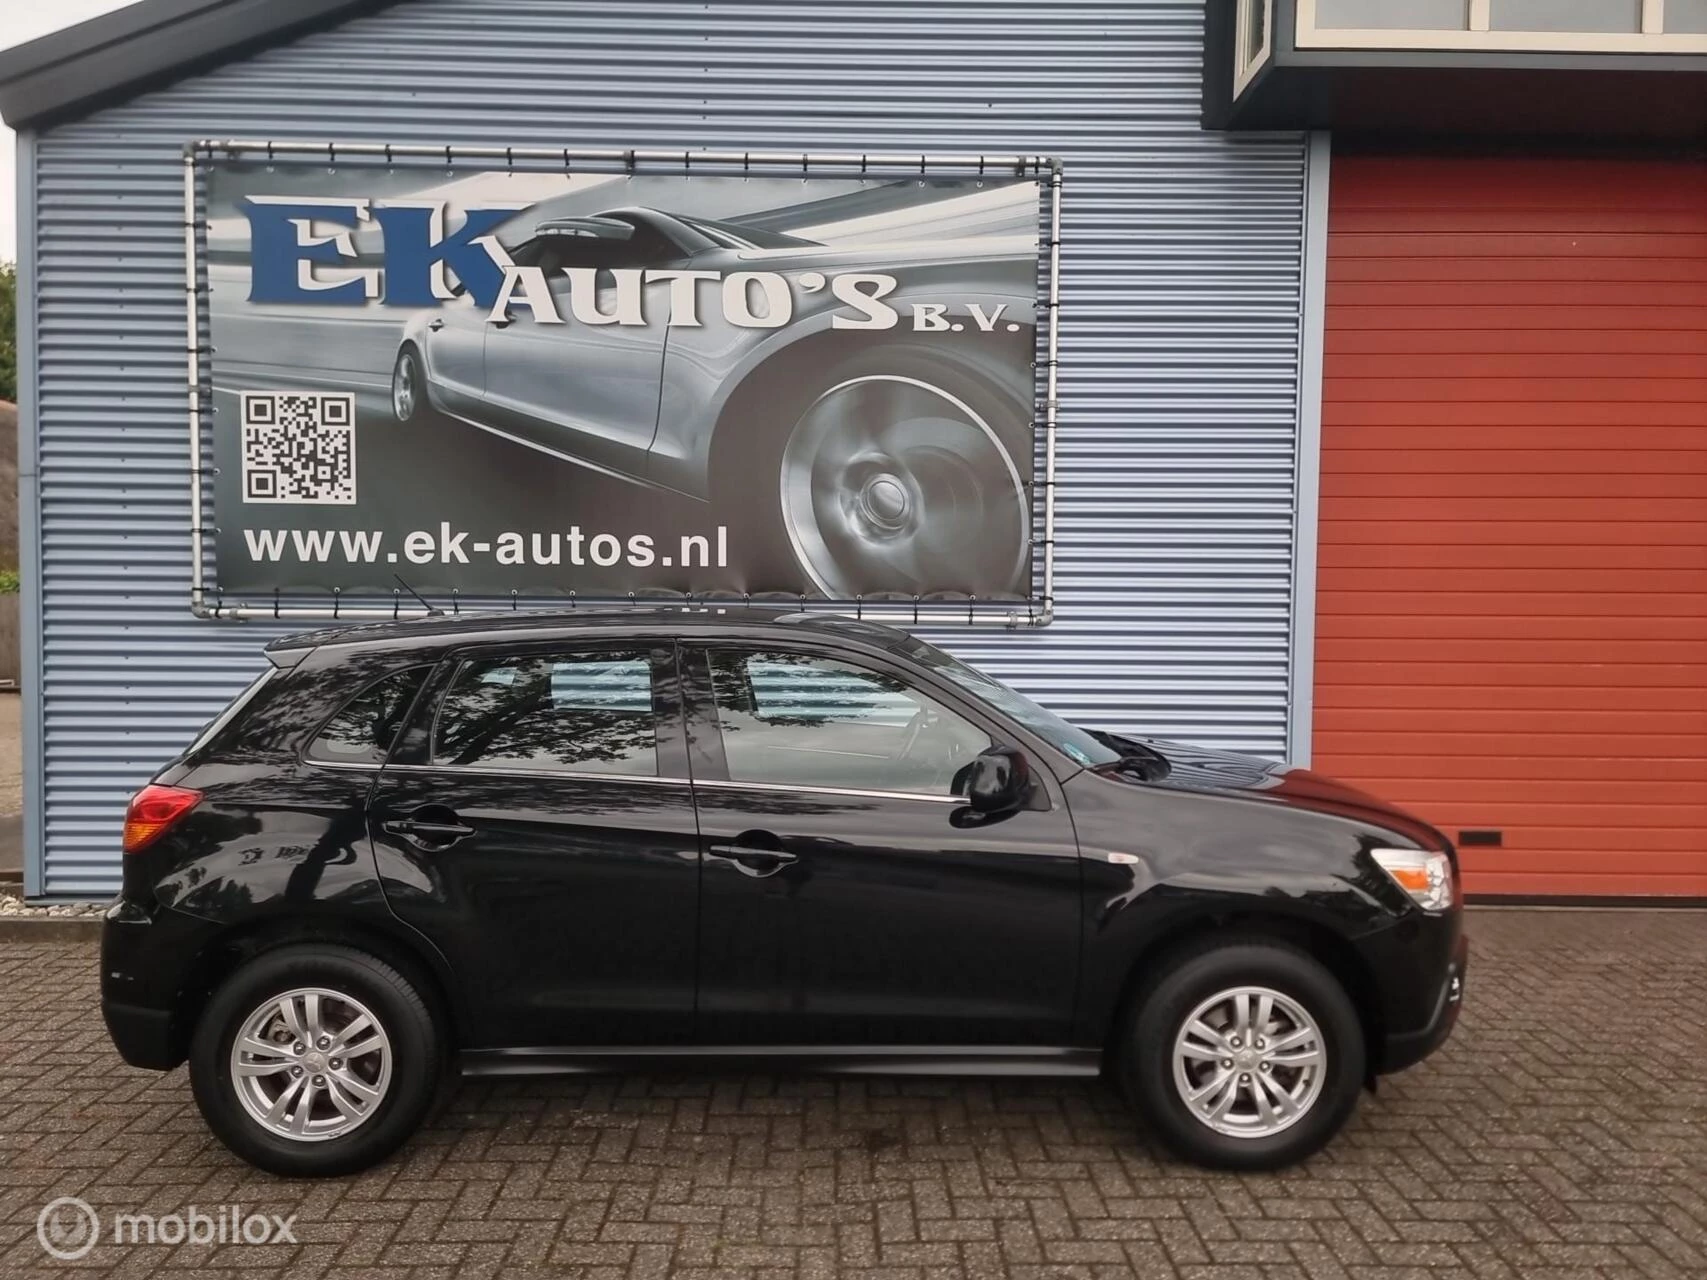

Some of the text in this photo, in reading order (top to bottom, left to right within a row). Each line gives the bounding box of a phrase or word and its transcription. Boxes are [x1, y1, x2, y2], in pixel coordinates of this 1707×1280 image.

[240, 195, 537, 310] EK
[911, 303, 1020, 333] B.V.
[243, 521, 729, 568] www.ek-autos.nl
